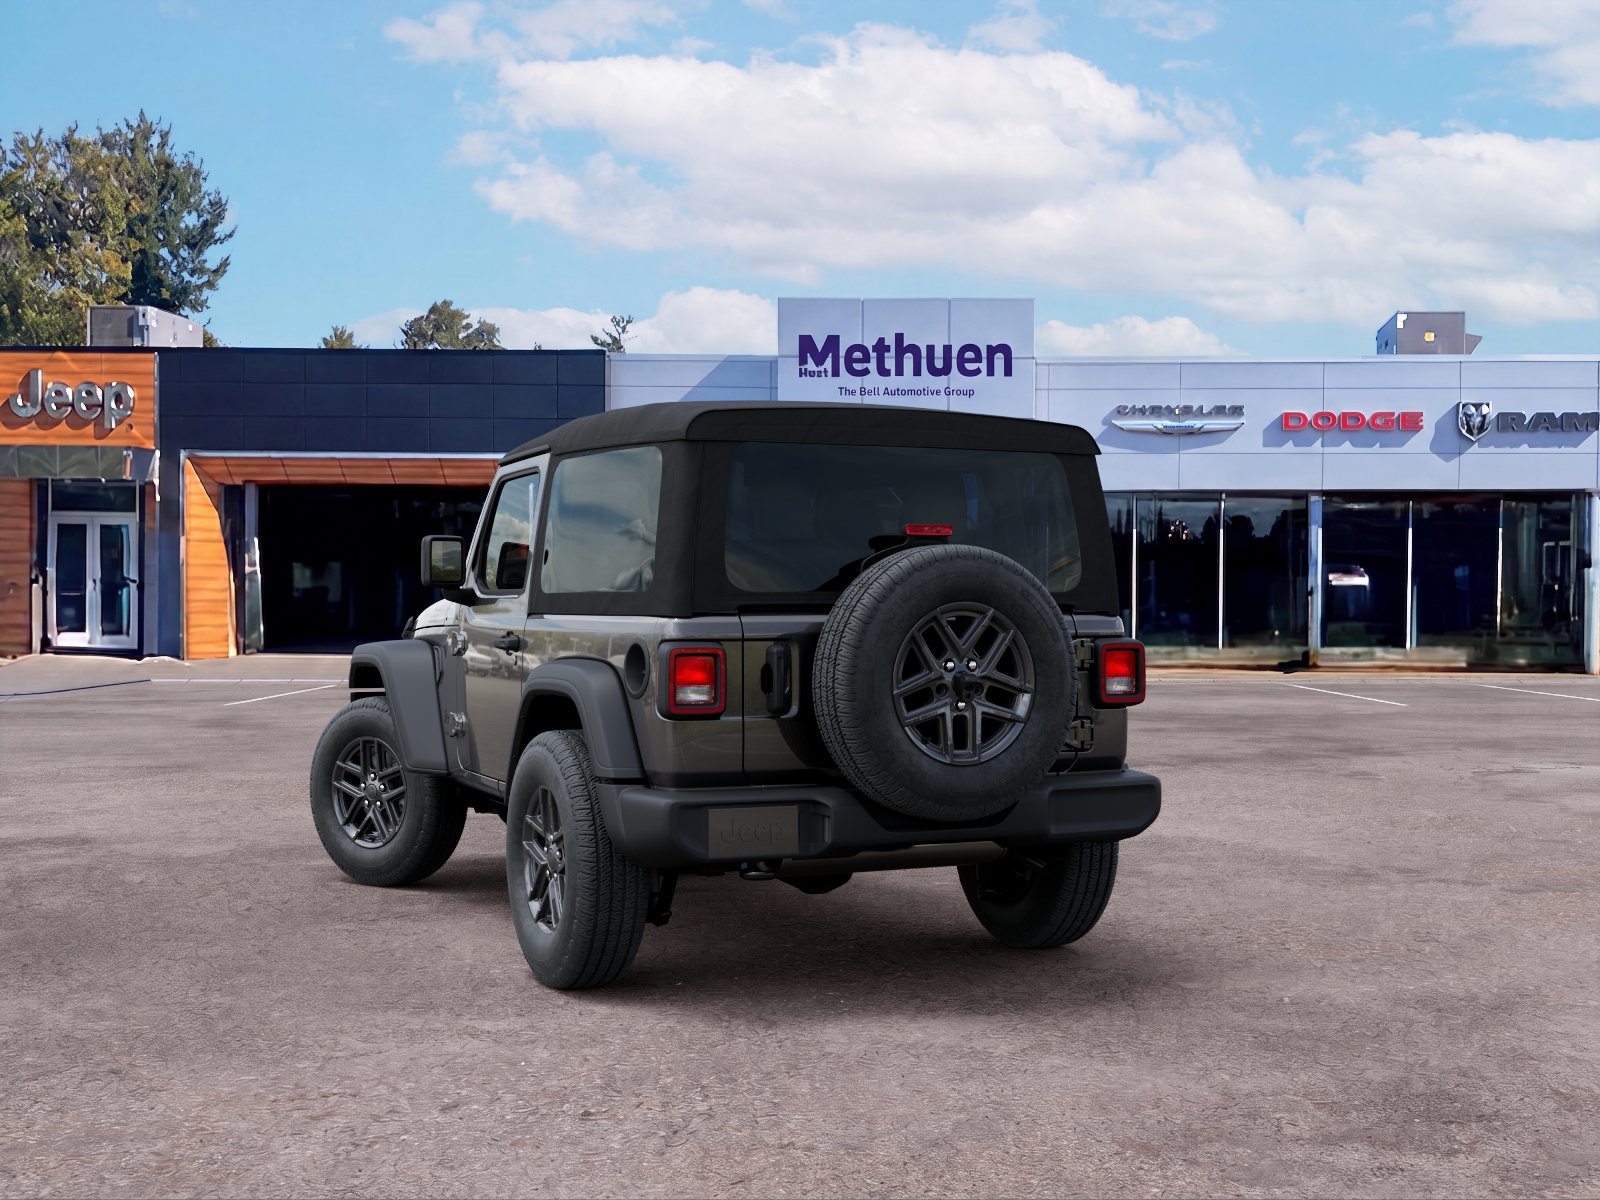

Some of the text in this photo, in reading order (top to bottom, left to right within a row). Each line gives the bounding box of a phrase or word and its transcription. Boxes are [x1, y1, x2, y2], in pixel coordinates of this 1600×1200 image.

[798, 332, 1013, 378] Methuen
[9, 368, 136, 429] Jeep
[838, 386, 975, 399] The Bell Automotive Group
[1282, 411, 1424, 431] DODGE
[1498, 411, 1600, 432] RAM
[719, 814, 785, 846] Jeep
